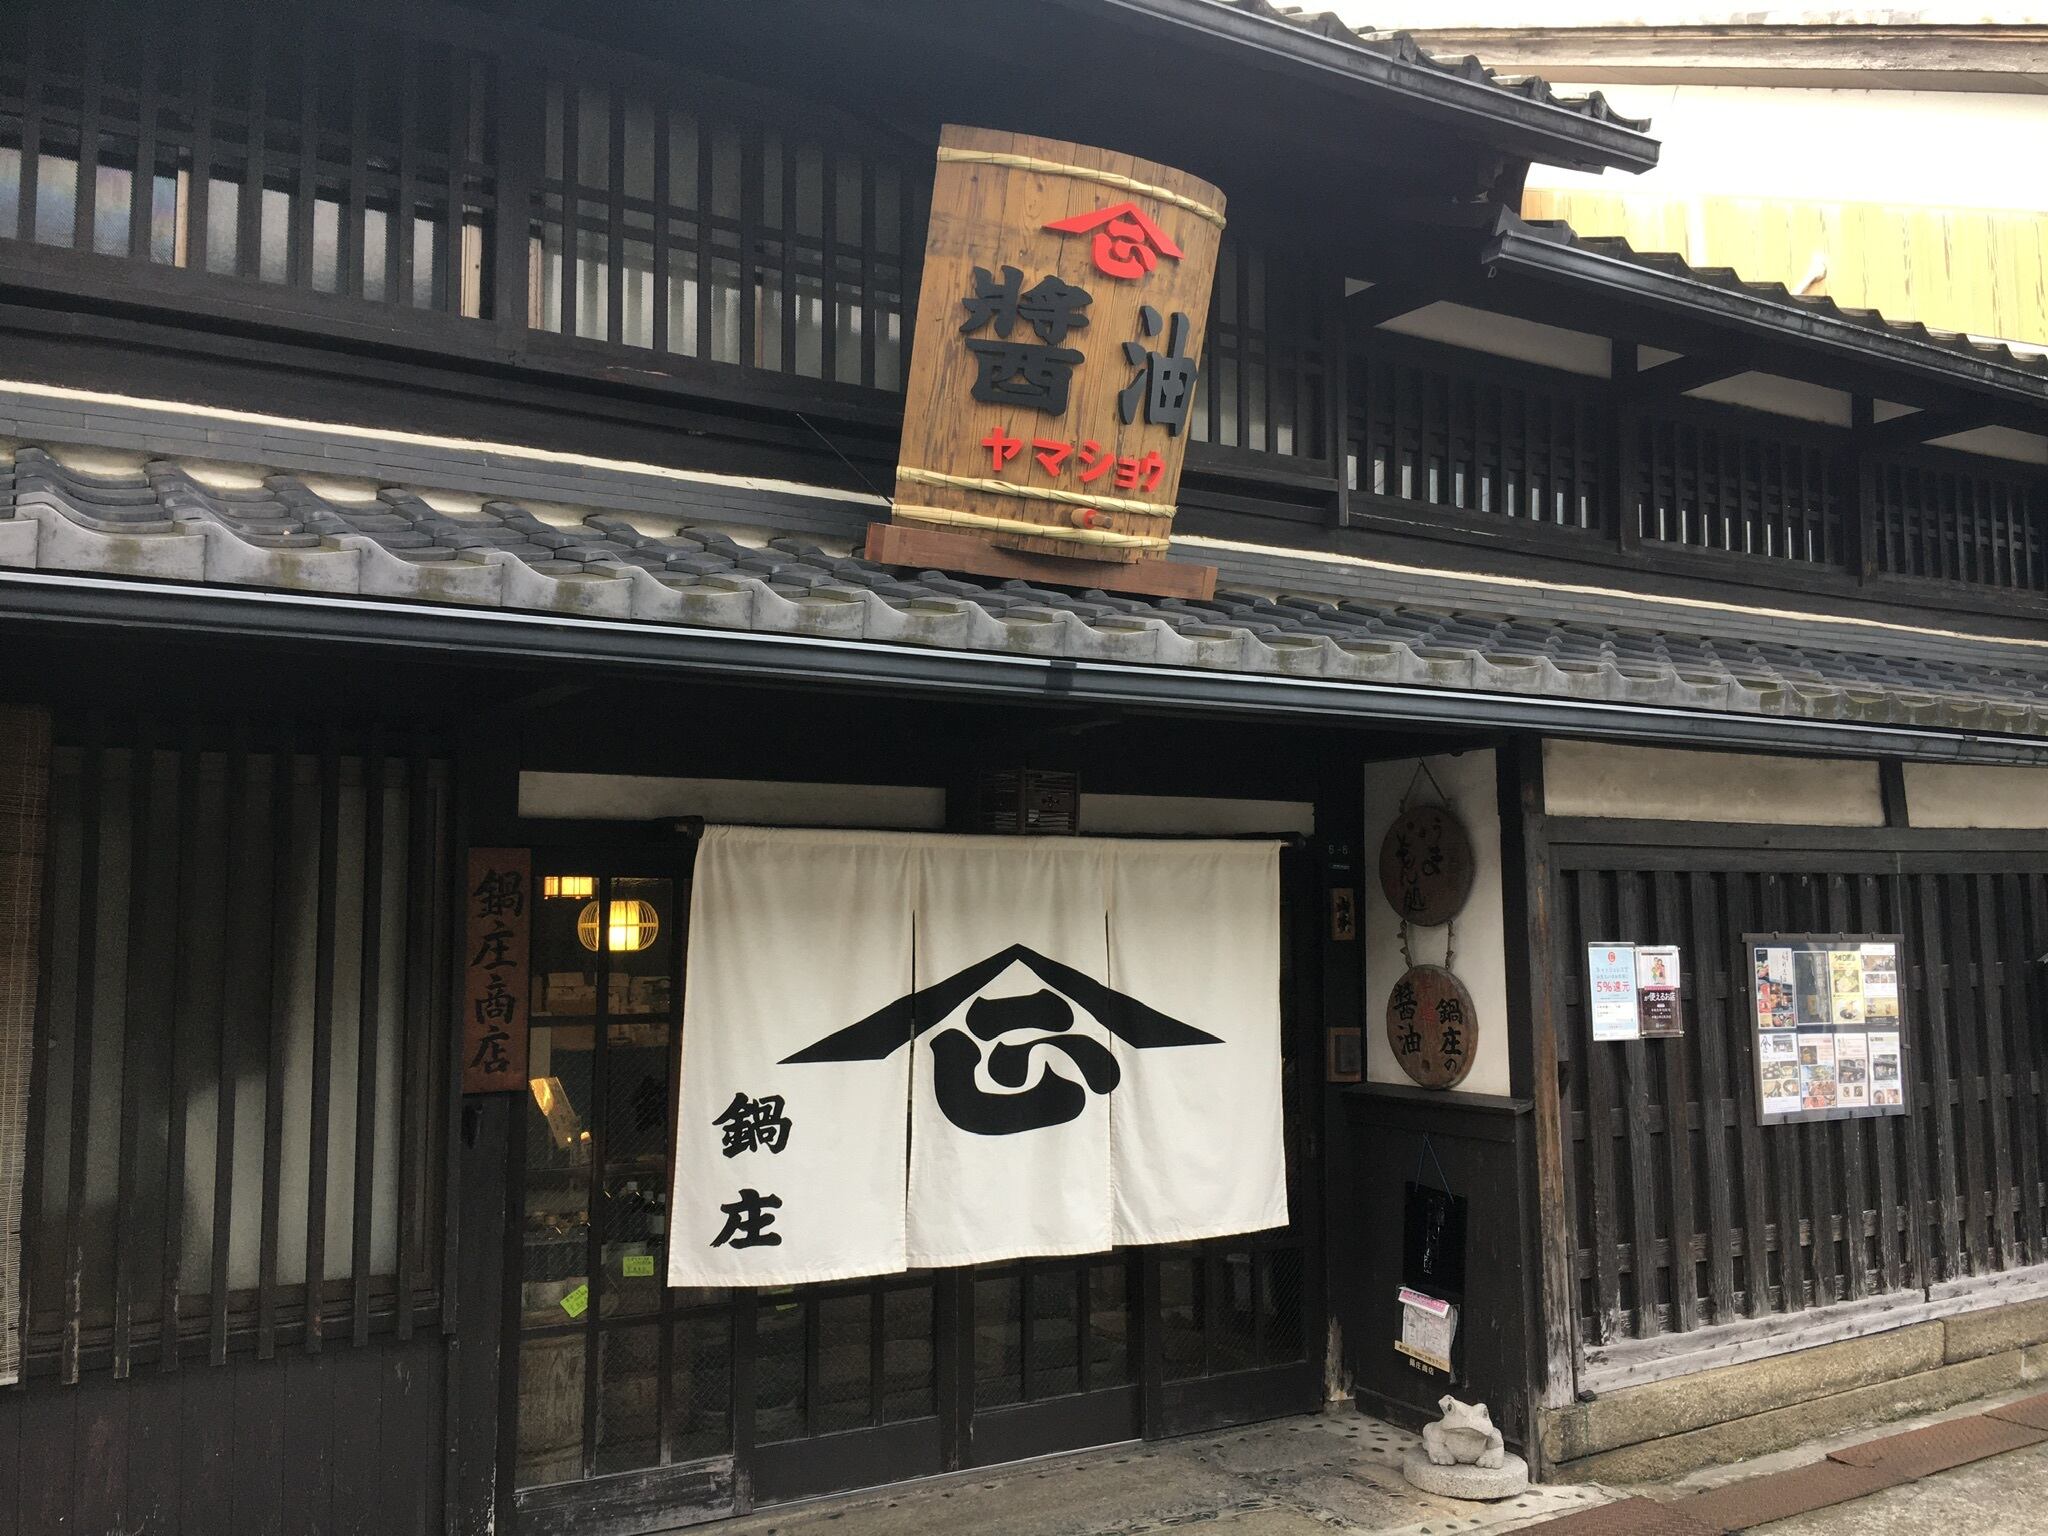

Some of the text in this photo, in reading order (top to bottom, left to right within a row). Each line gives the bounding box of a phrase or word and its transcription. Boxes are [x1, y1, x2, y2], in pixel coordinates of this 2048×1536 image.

[981, 426, 1166, 492] ヤマショウ
[469, 868, 523, 1074] 鍋庄商店
[1596, 981, 1631, 993] 5%還元
[710, 1091, 793, 1250] 鍋庄
